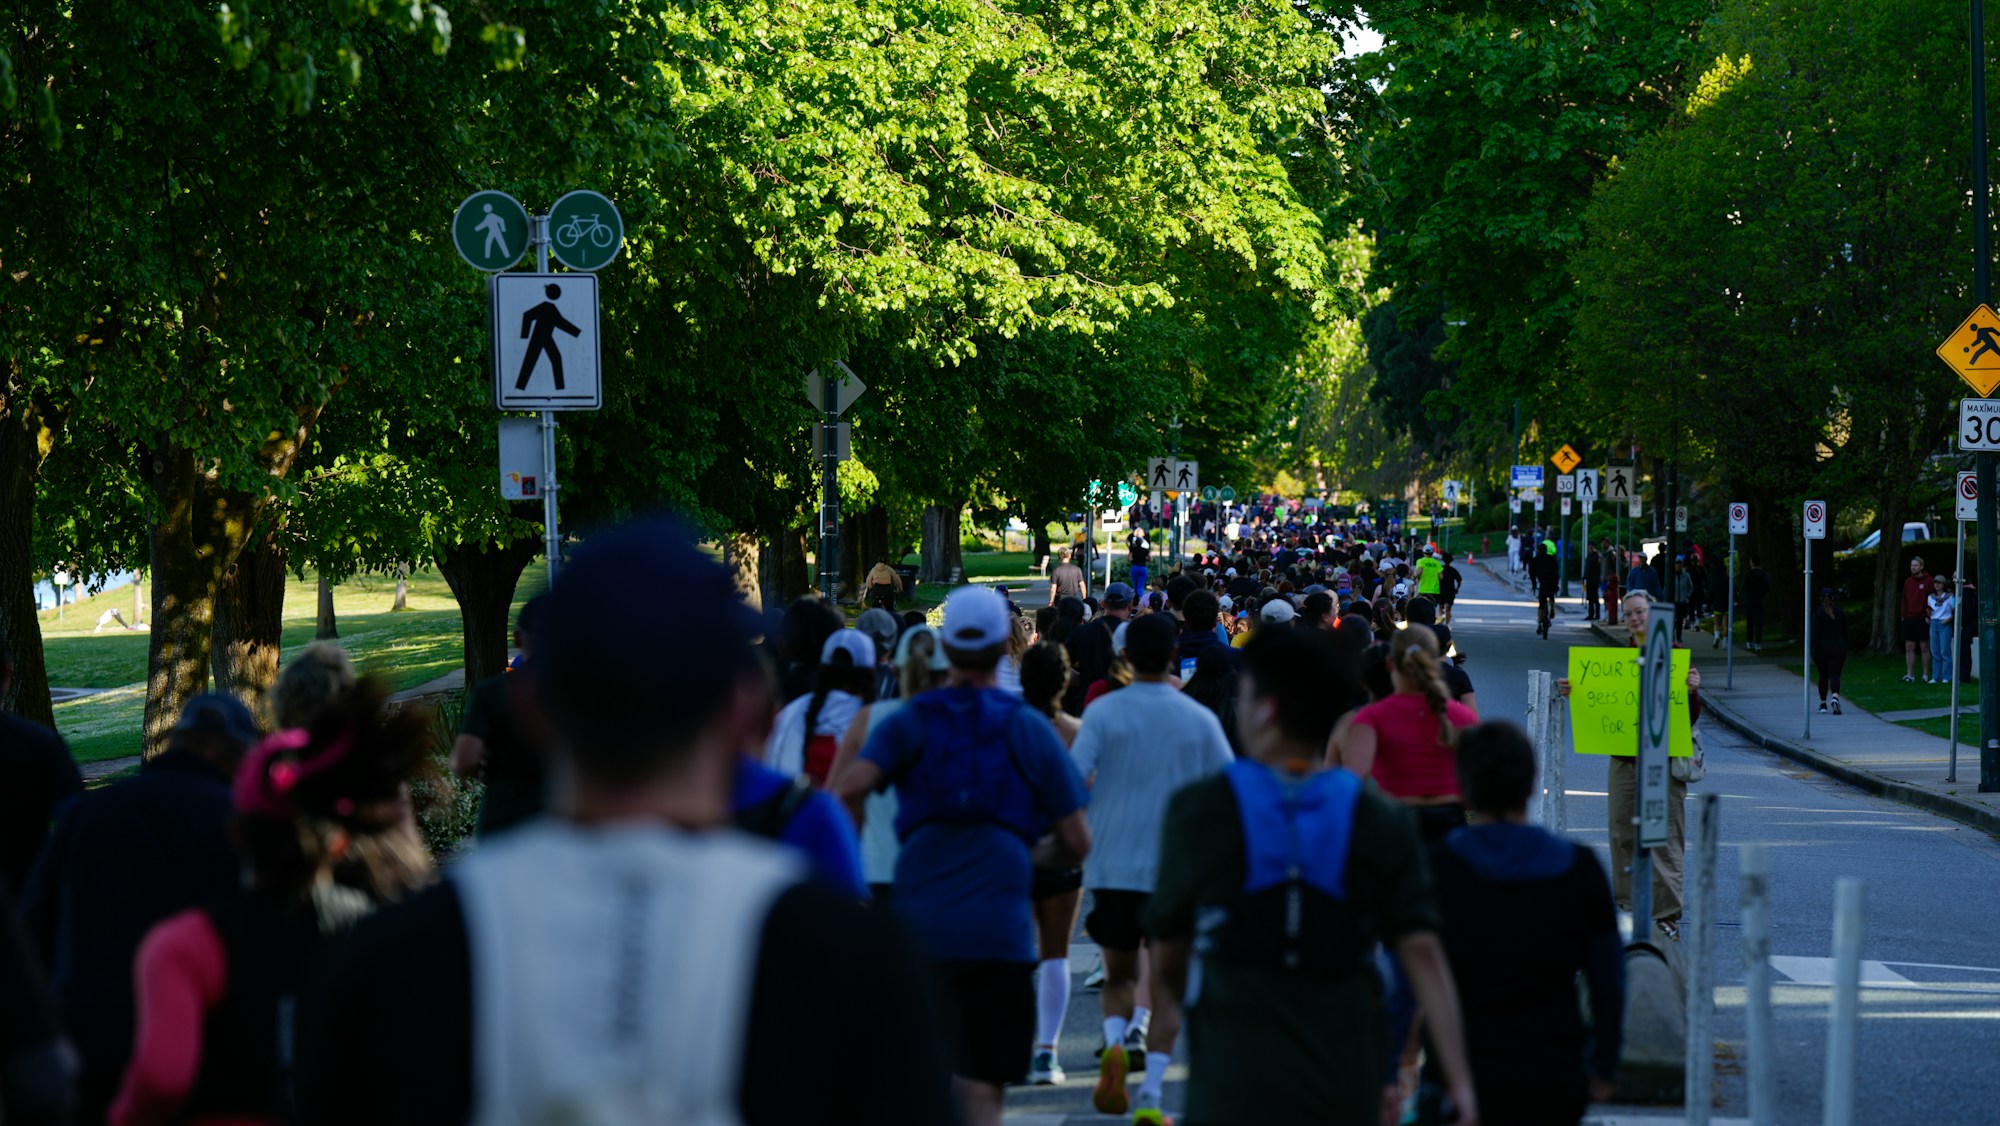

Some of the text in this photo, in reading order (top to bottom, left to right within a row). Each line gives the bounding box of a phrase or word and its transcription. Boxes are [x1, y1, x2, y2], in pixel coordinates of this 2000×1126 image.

[1967, 404, 2000, 413] MAXIMU
[1965, 416, 2000, 444] 30
[1559, 481, 1572, 490] 30
[1580, 660, 1623, 685] YOUR
